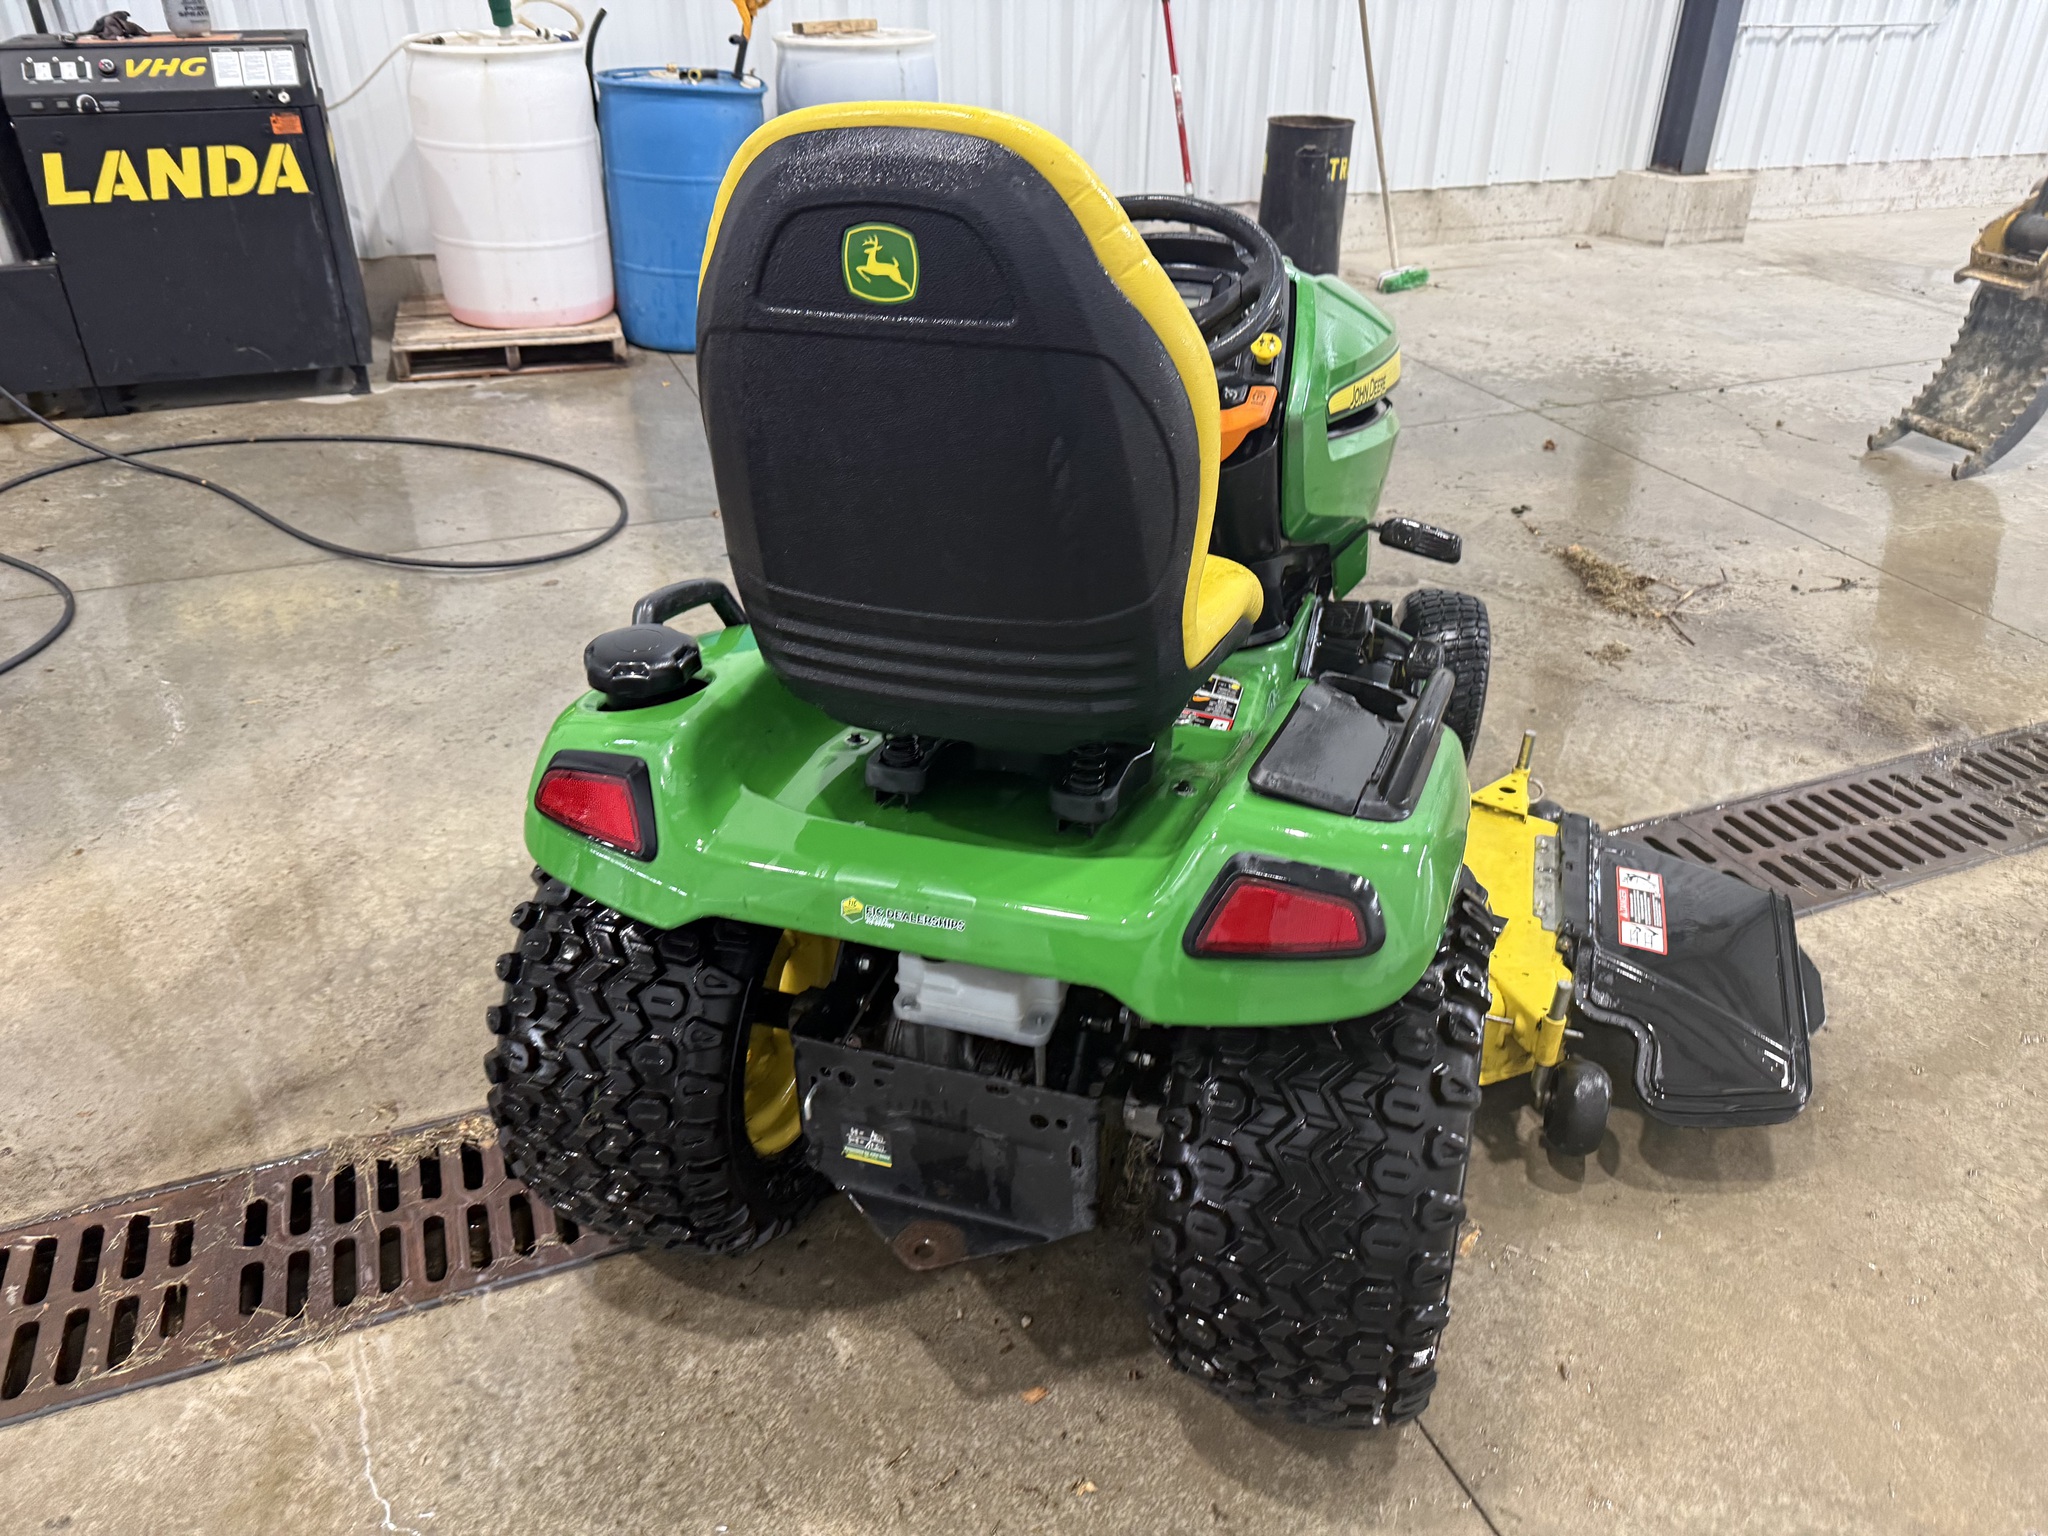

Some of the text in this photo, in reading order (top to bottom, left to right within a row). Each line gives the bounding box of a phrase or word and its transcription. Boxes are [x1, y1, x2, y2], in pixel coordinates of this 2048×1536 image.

[125, 57, 208, 78] VHG
[42, 143, 311, 206] LANDA
[1350, 375, 1387, 406] JOHN DEERE
[886, 907, 967, 932] DEALERSHIPS
